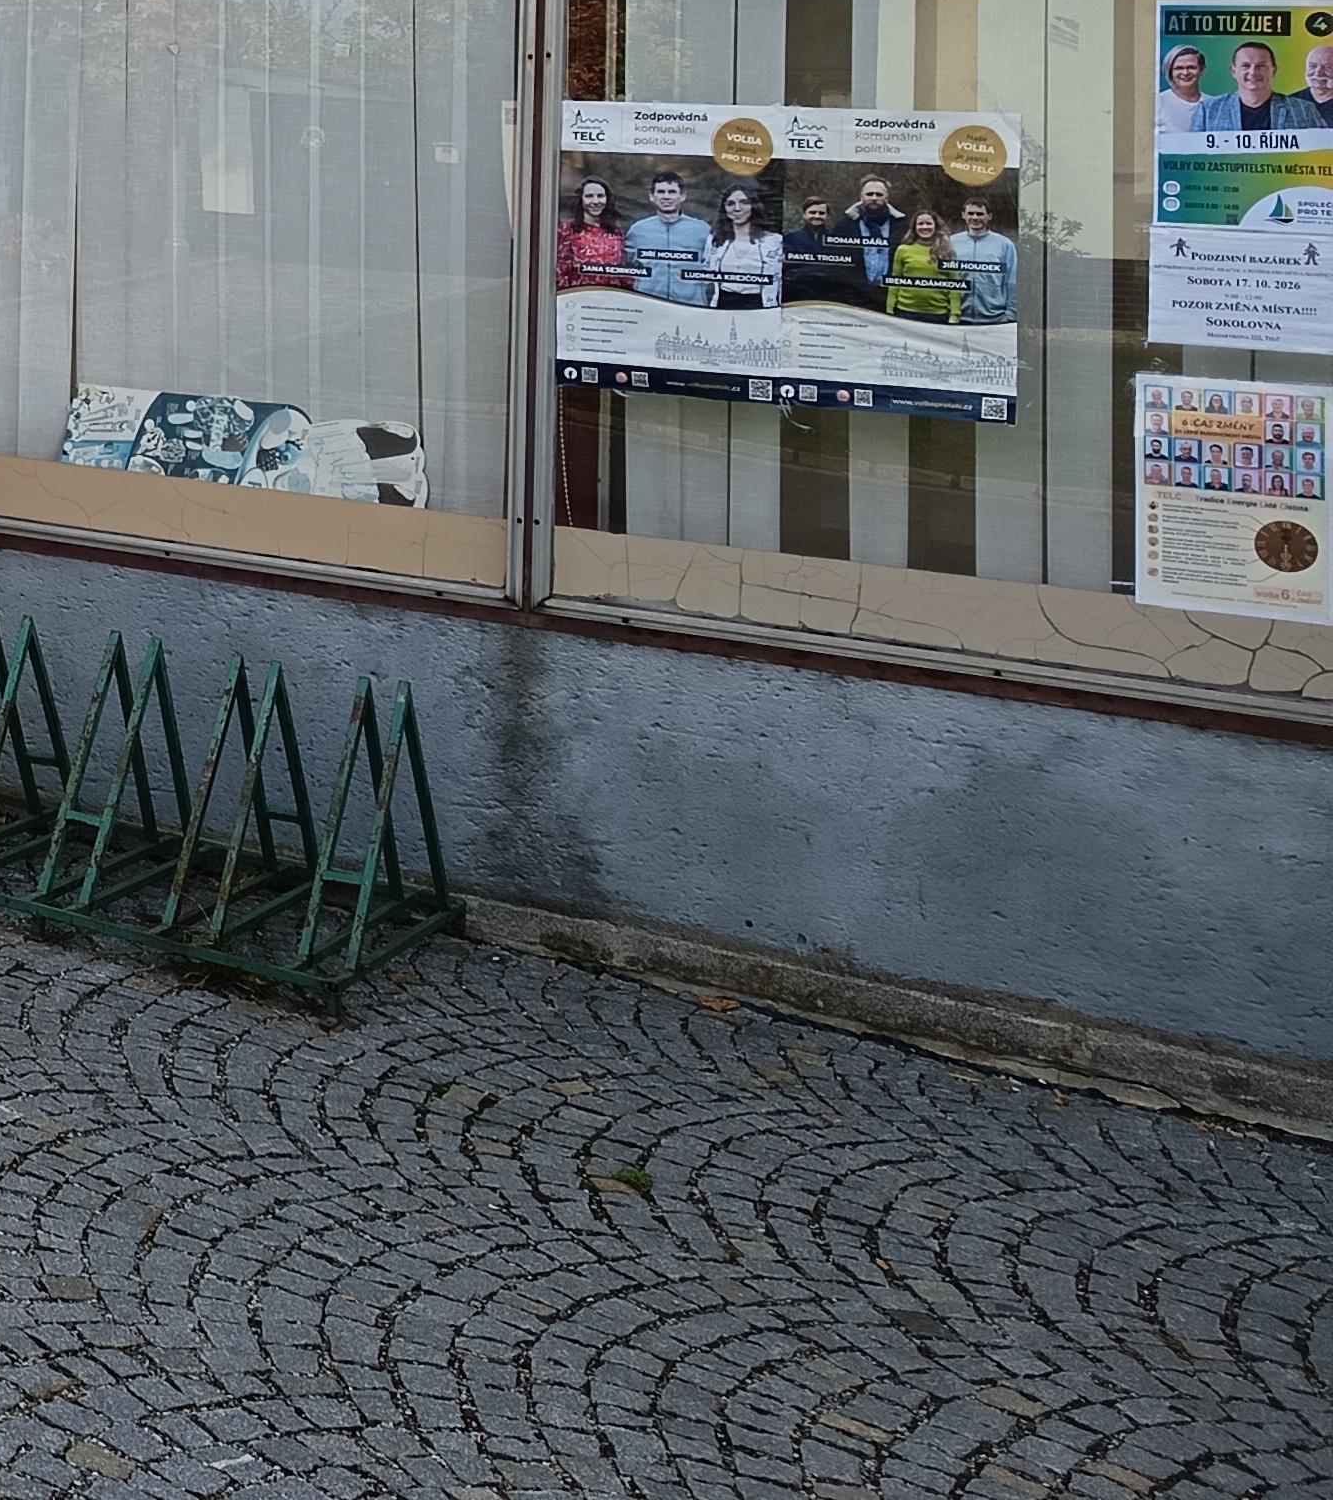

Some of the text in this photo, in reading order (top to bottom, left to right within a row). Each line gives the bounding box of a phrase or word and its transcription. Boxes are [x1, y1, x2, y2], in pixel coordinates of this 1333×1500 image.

[1168, 12, 1189, 31] AŤ
[1193, 15, 1213, 32] TO
[1217, 15, 1237, 32] TU
[1241, 12, 1273, 32] ŽIJE
[1311, 17, 1328, 31] 4
[634, 111, 708, 123] Zodpovědná
[634, 124, 696, 135] komunální
[855, 118, 935, 130] Zodpovědná
[572, 130, 606, 142] TELČ
[634, 136, 676, 147] politika
[726, 132, 763, 145] VOLBA
[855, 131, 923, 142] komunální
[1206, 133, 1220, 148] 9.
[1235, 134, 1256, 149] 10.
[1259, 132, 1299, 149] ŘÍJNA
[788, 136, 824, 149] TELČ
[956, 140, 995, 155] VOLBA
[855, 144, 901, 155] politika
[1207, 162, 1283, 174] ZASTUPITELSTVA
[1284, 163, 1315, 175] MĚSTA
[960, 262, 1001, 272] HOUDEK
[885, 277, 912, 286] IRENA
[1236, 278, 1252, 288] 17.
[1256, 279, 1271, 289] 10.
[1274, 280, 1301, 290] 2026
[1172, 300, 1213, 310] POZOR
[1215, 301, 1259, 313] ZMĚNA
